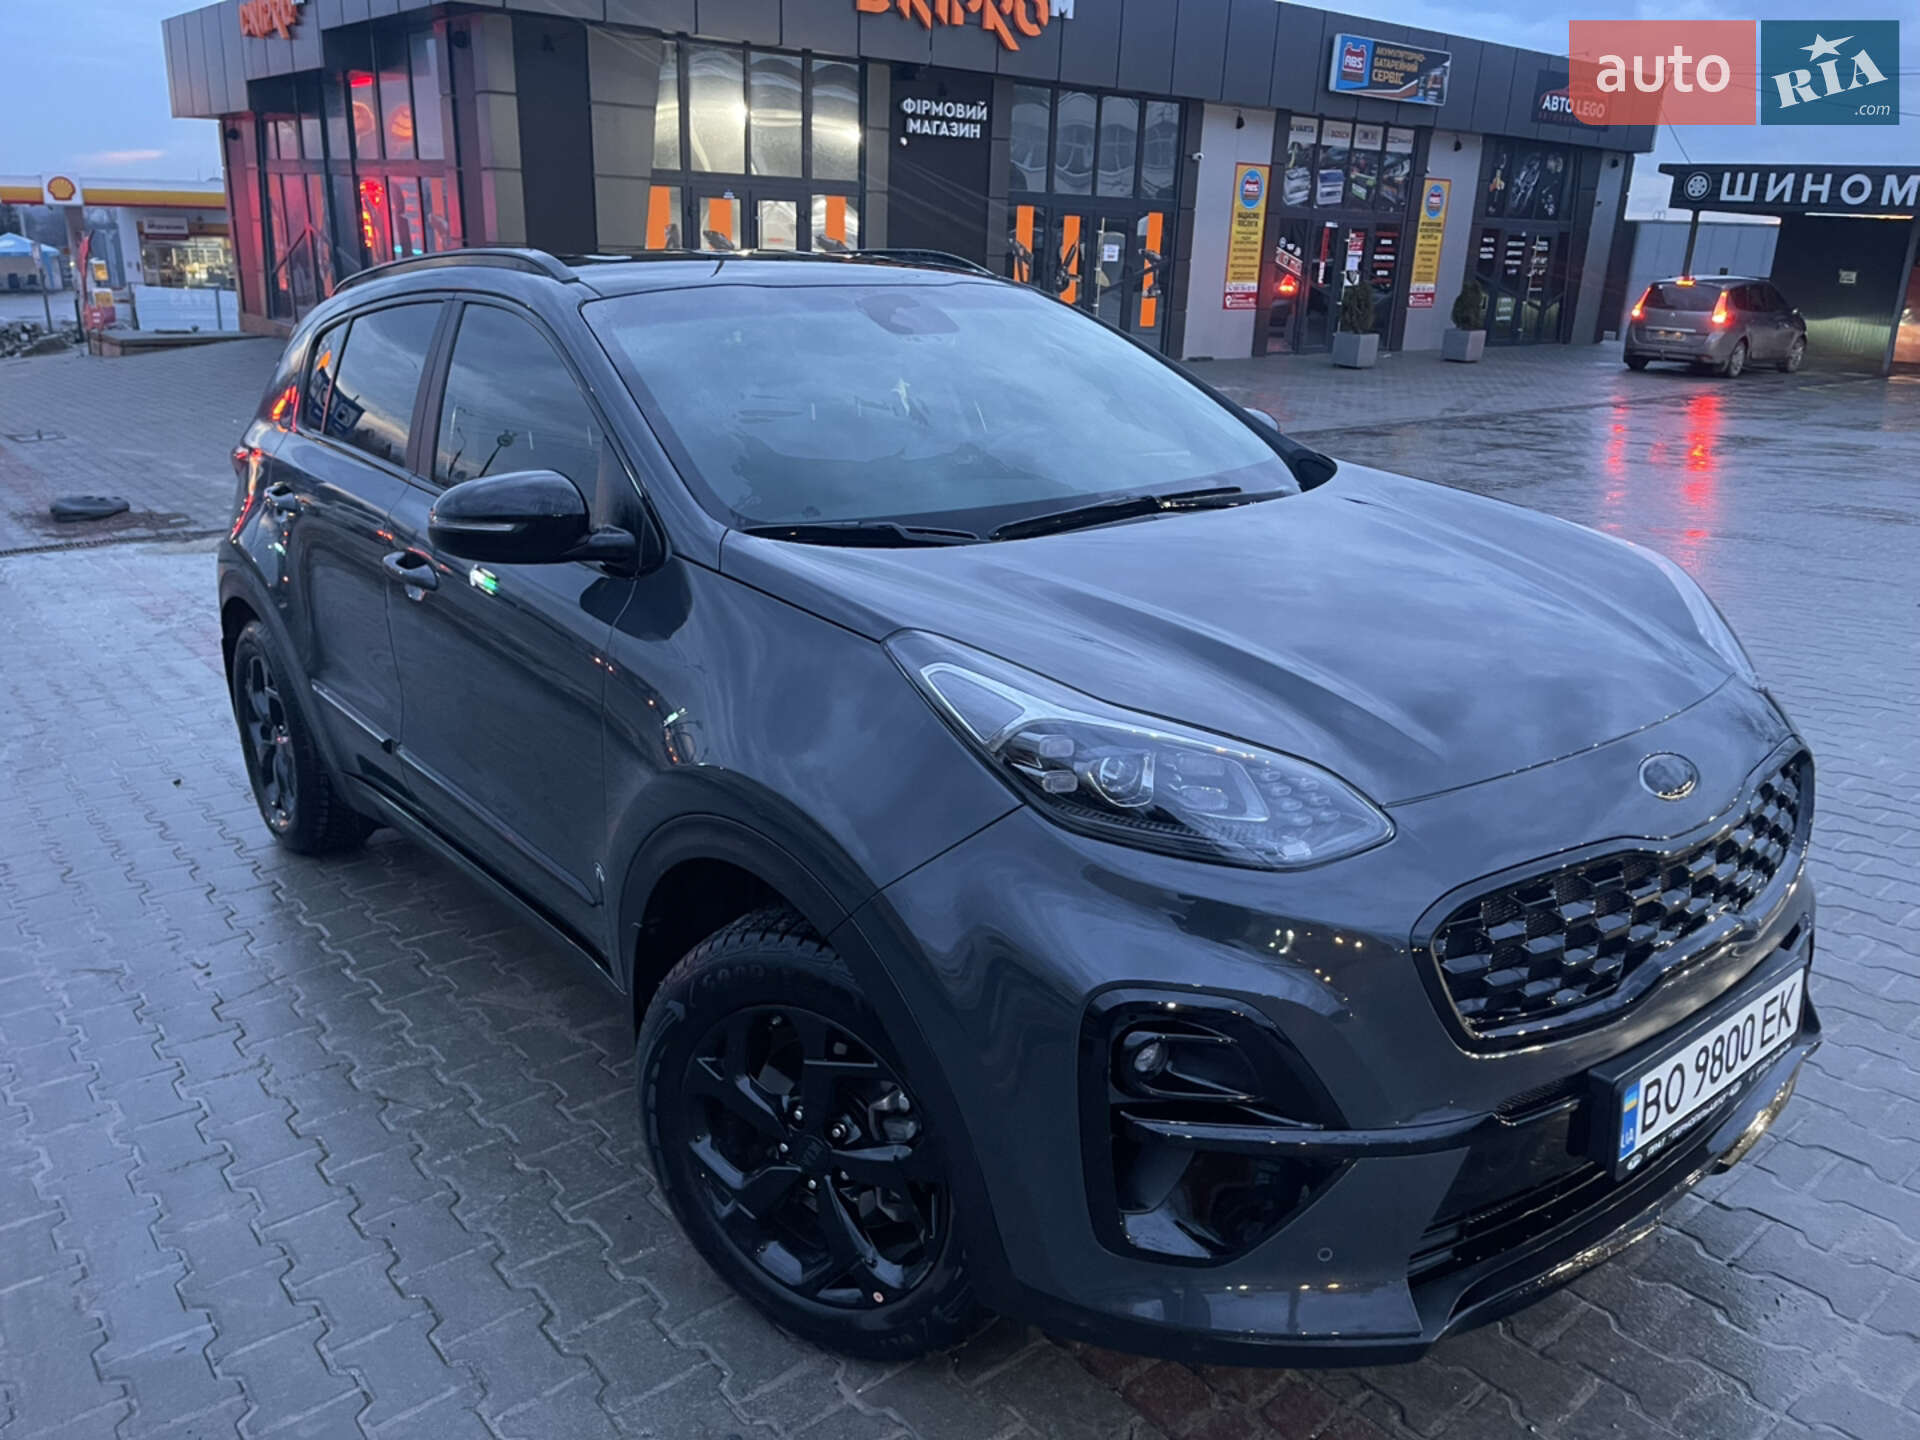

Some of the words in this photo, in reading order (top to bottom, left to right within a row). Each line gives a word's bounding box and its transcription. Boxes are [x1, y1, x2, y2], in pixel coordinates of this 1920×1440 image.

[1344, 55, 1364, 69] ABS
[1372, 68, 1405, 85] СЕРВІС
[902, 97, 988, 121] ФІРМОВИЙ
[1575, 98, 1606, 118] LEGO
[906, 118, 981, 139] МАГАЗИН
[1719, 171, 1920, 206] ШИНОМ
[1641, 1062, 1686, 1135] BO
[1693, 1013, 1756, 1099] 9800
[1760, 981, 1797, 1050] EK
